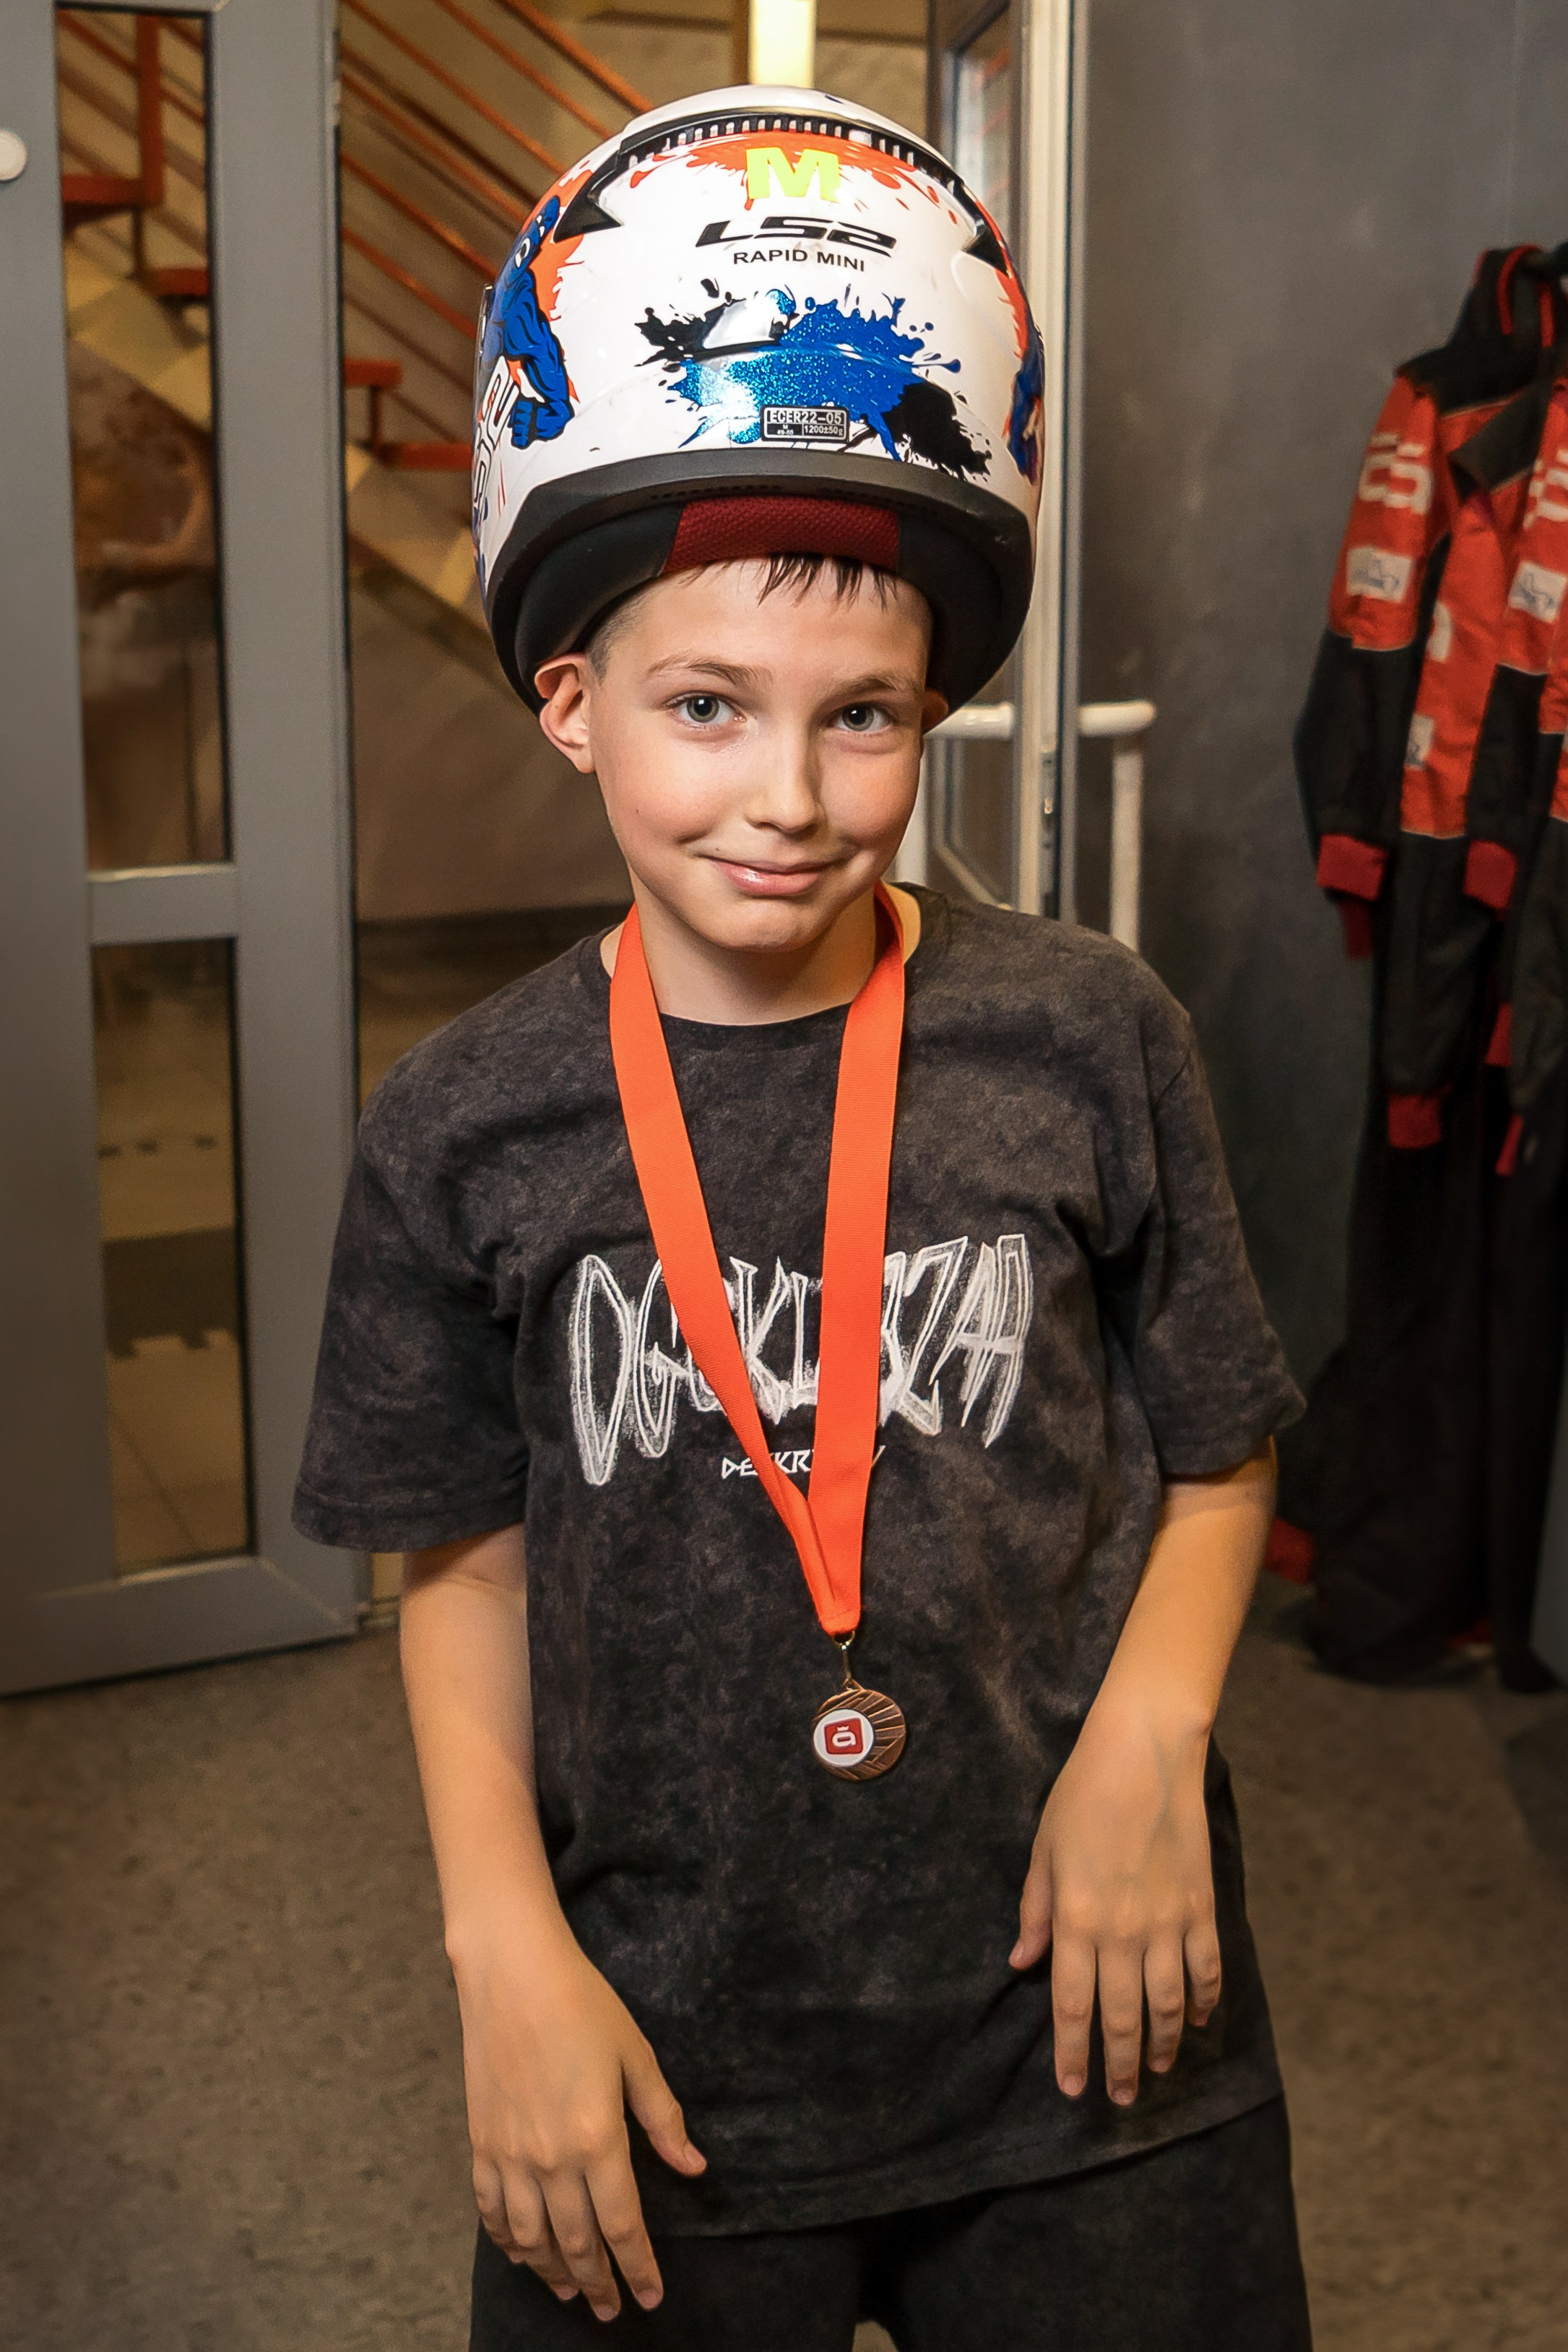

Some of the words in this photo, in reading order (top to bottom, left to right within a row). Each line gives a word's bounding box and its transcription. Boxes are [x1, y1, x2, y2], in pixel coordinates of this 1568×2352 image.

[745, 146, 841, 204] M
[695, 216, 897, 258] LS2
[733, 249, 808, 264] RAPID
[817, 251, 865, 272] MINI
